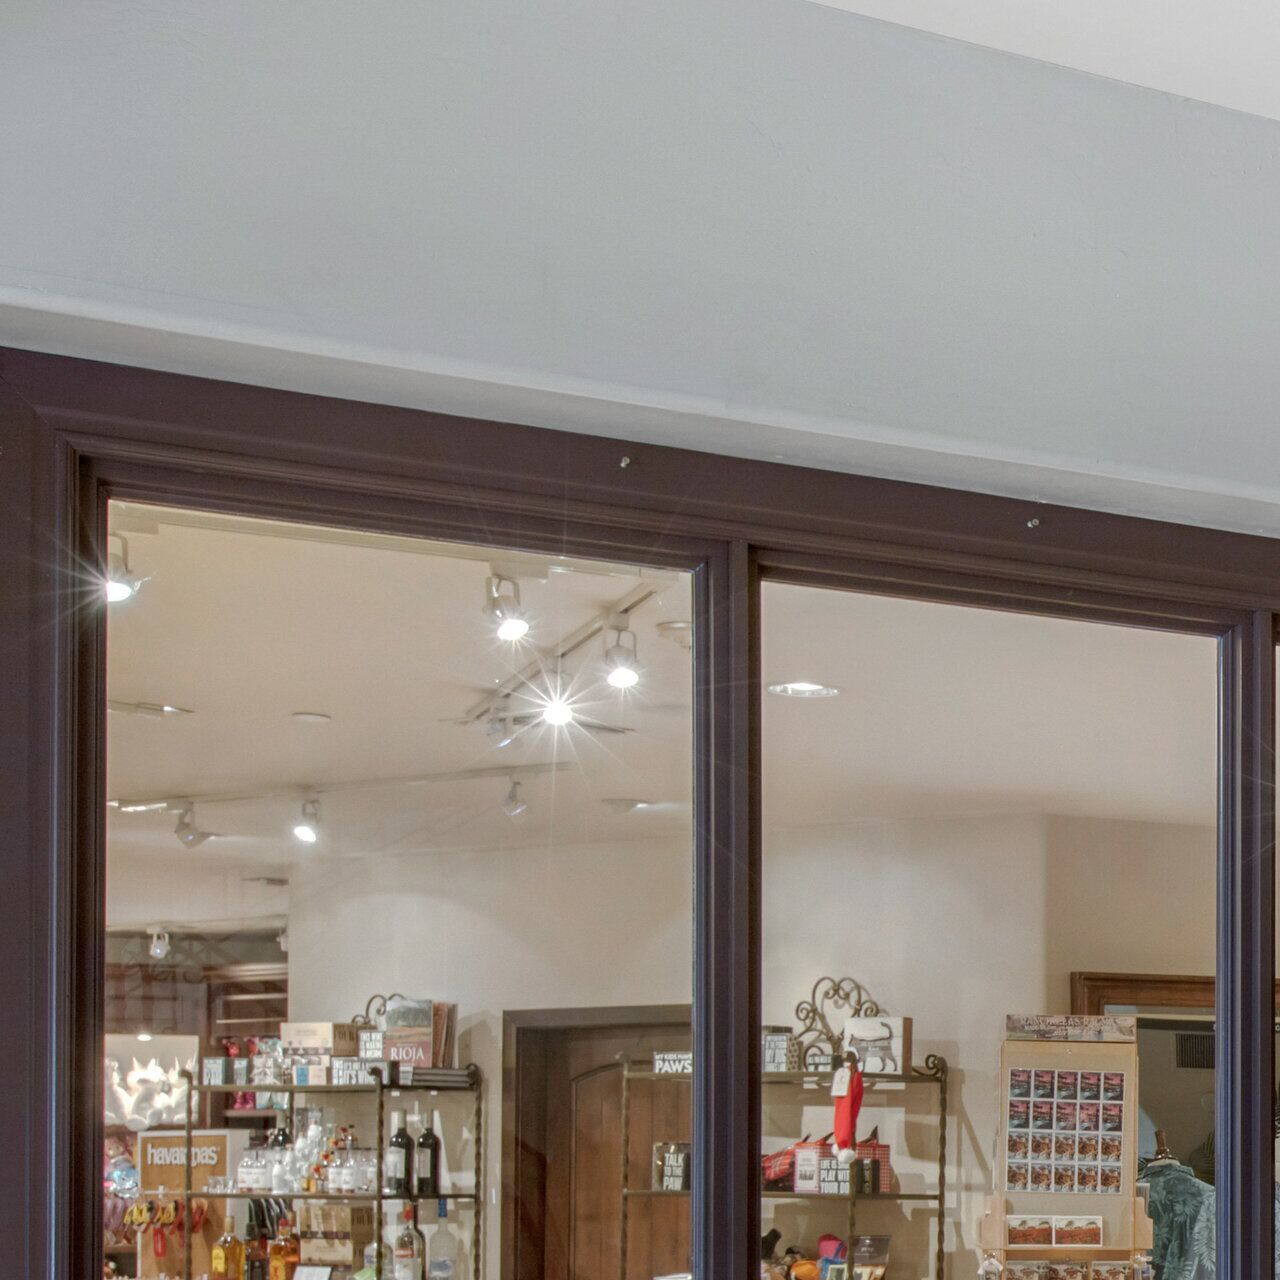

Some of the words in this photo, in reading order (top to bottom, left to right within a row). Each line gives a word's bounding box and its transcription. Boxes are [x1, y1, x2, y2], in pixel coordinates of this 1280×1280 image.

[390, 1046, 425, 1062] RIOJA
[656, 1060, 692, 1073] PAWS
[664, 1153, 685, 1166] TALK
[664, 1166, 672, 1175] TO
[673, 1166, 684, 1176] THE
[820, 1170, 836, 1181] PLAY
[837, 1170, 850, 1181] WIT
[663, 1177, 683, 1190] PAW
[839, 1182, 850, 1194] DO
